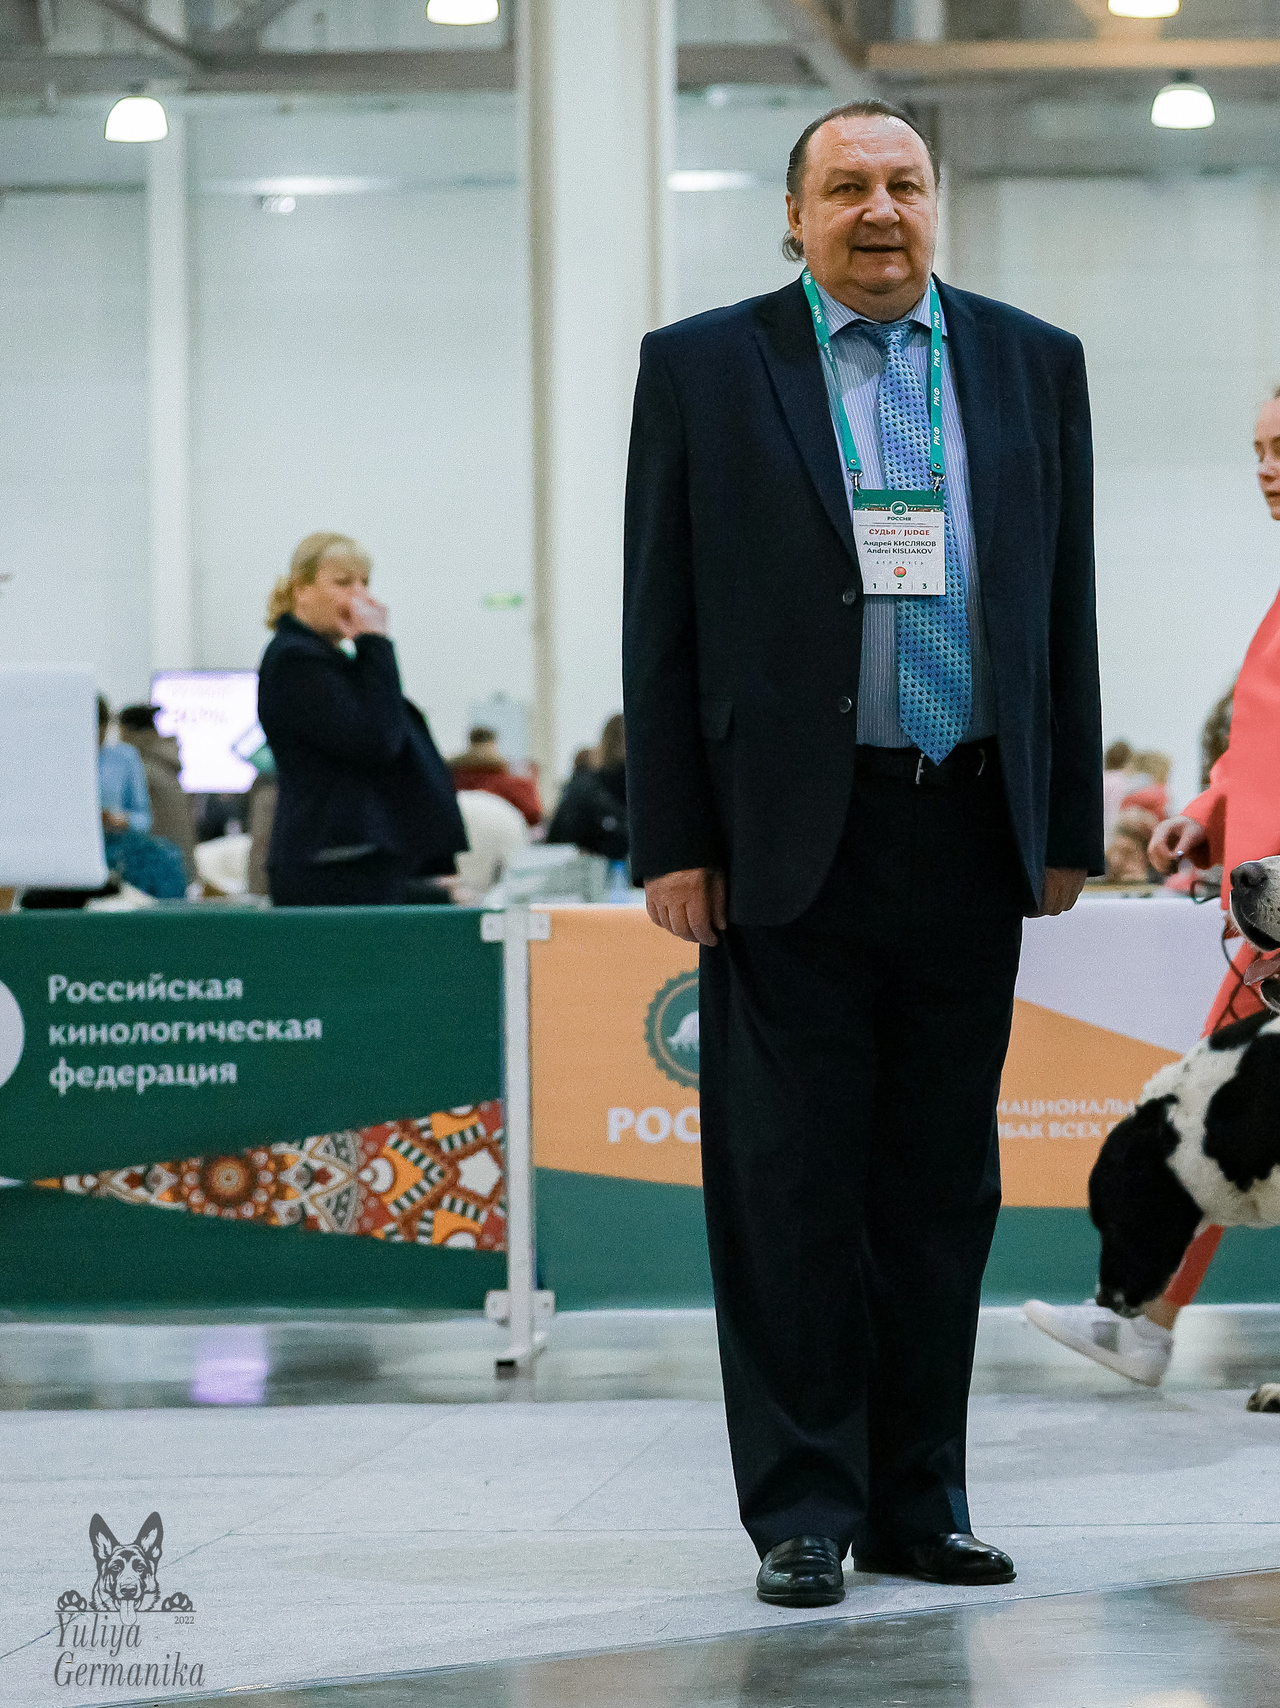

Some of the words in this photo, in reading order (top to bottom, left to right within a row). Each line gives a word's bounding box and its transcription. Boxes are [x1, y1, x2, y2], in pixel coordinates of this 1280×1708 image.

[813, 304, 822, 324] РКФ
[933, 311, 941, 329] РКФ
[933, 348, 941, 368] РКФ
[933, 387, 941, 407] РКФ
[933, 426, 941, 446] РКФ
[868, 528, 896, 536] СУДЬЯ
[903, 529, 930, 537] JUDGE
[863, 540, 892, 548] Андрей
[48, 973, 243, 1003] Российская
[49, 1018, 323, 1045] кинологическая
[49, 1056, 238, 1097] федерация
[607, 1107, 701, 1144] РОС
[1049, 1121, 1101, 1138] ВСЕХ
